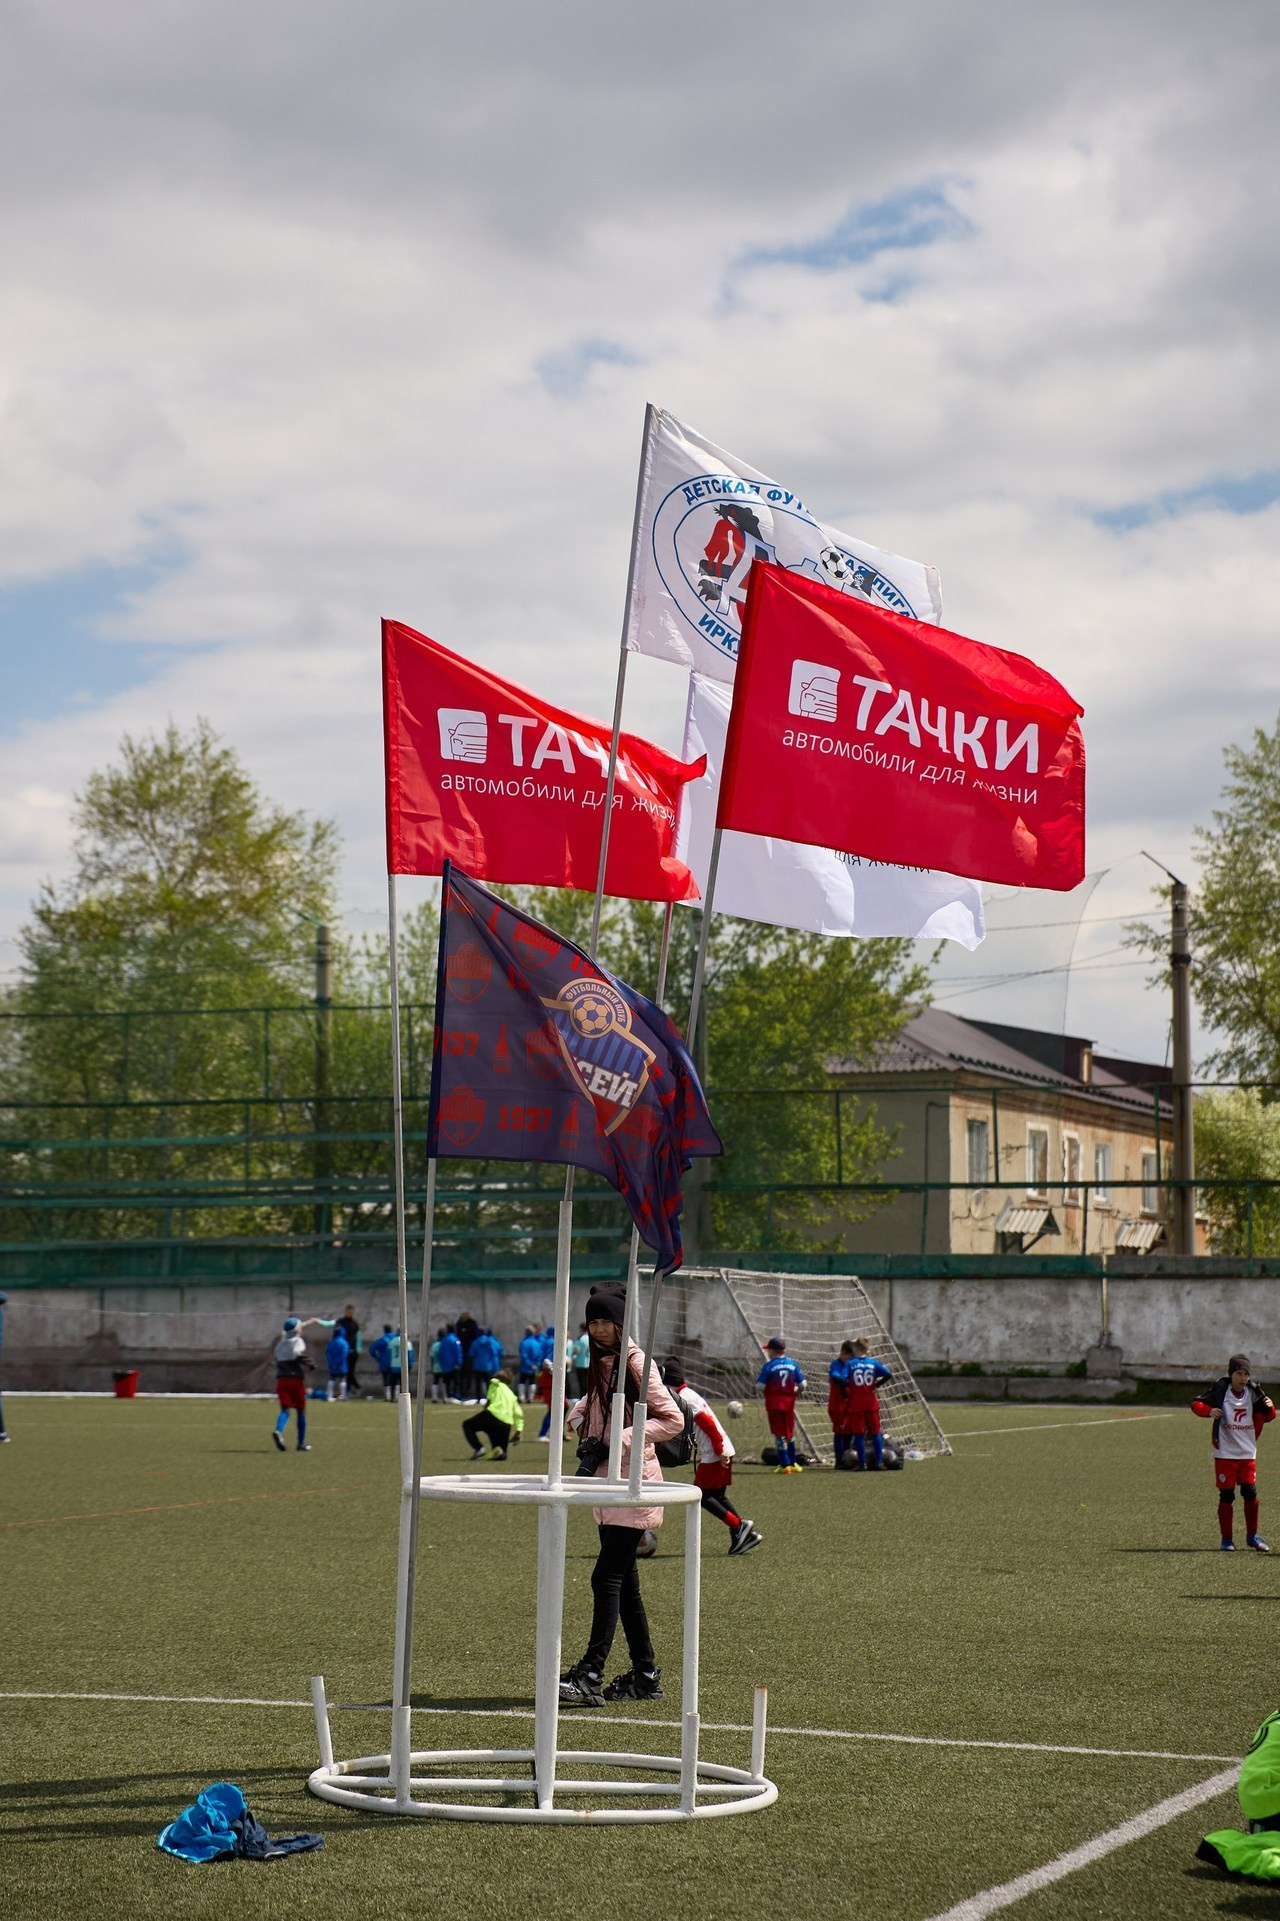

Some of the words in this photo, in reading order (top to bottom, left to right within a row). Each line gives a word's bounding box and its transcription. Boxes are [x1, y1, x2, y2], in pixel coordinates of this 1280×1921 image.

[682, 478, 761, 506] ДЕТСКАЯ
[852, 675, 1039, 774] ТАЧКИ
[782, 729, 916, 776] автомобили
[919, 764, 966, 785] для
[440, 774, 576, 804] автомобили
[498, 1105, 552, 1132] 1937
[779, 1370, 789, 1387] 7
[853, 1369, 874, 1387] 66
